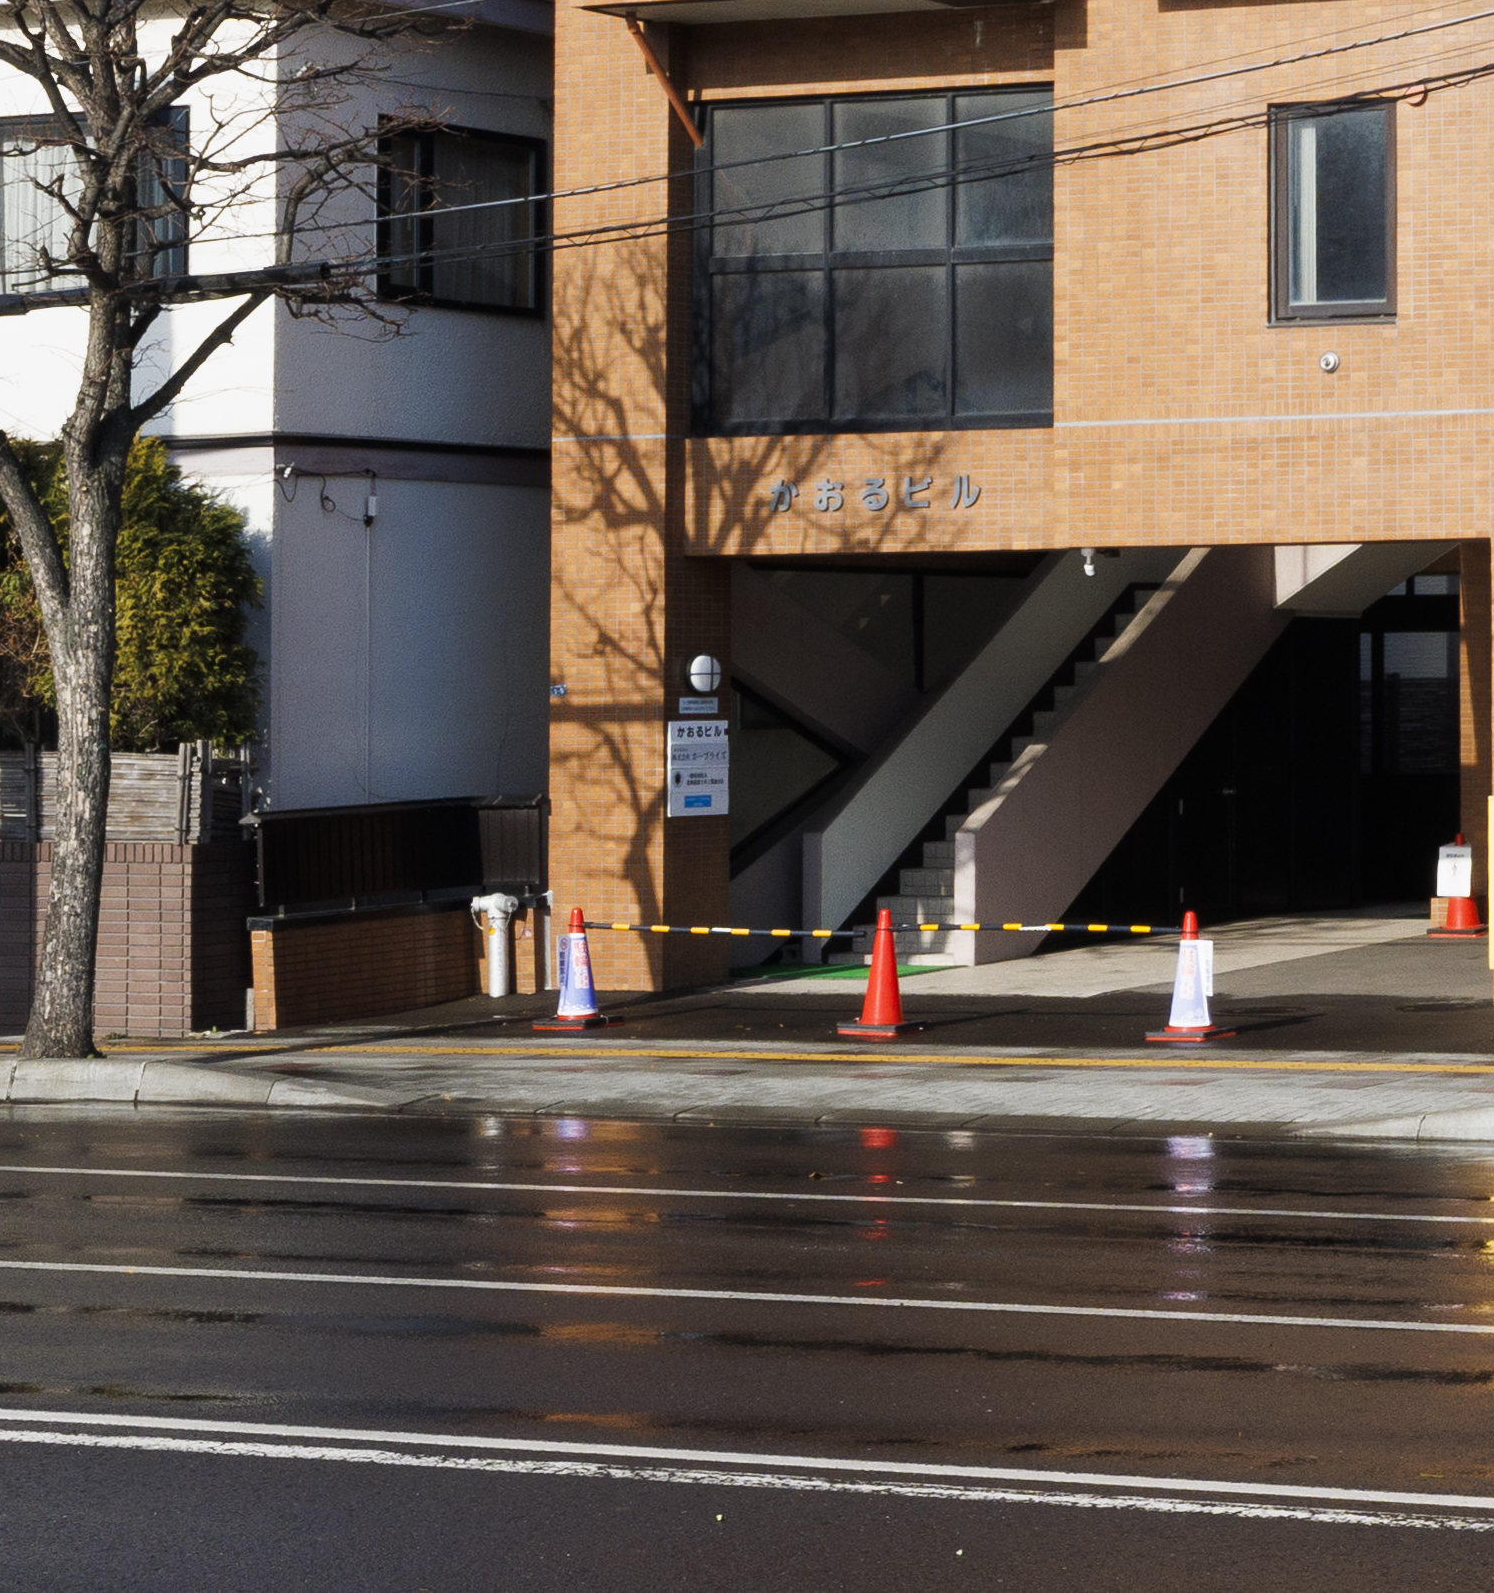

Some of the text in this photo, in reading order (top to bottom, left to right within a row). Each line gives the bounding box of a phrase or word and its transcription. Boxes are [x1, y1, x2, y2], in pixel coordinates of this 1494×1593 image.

[768, 474, 982, 512] かおるビル
[677, 725, 722, 738] かおるビル
